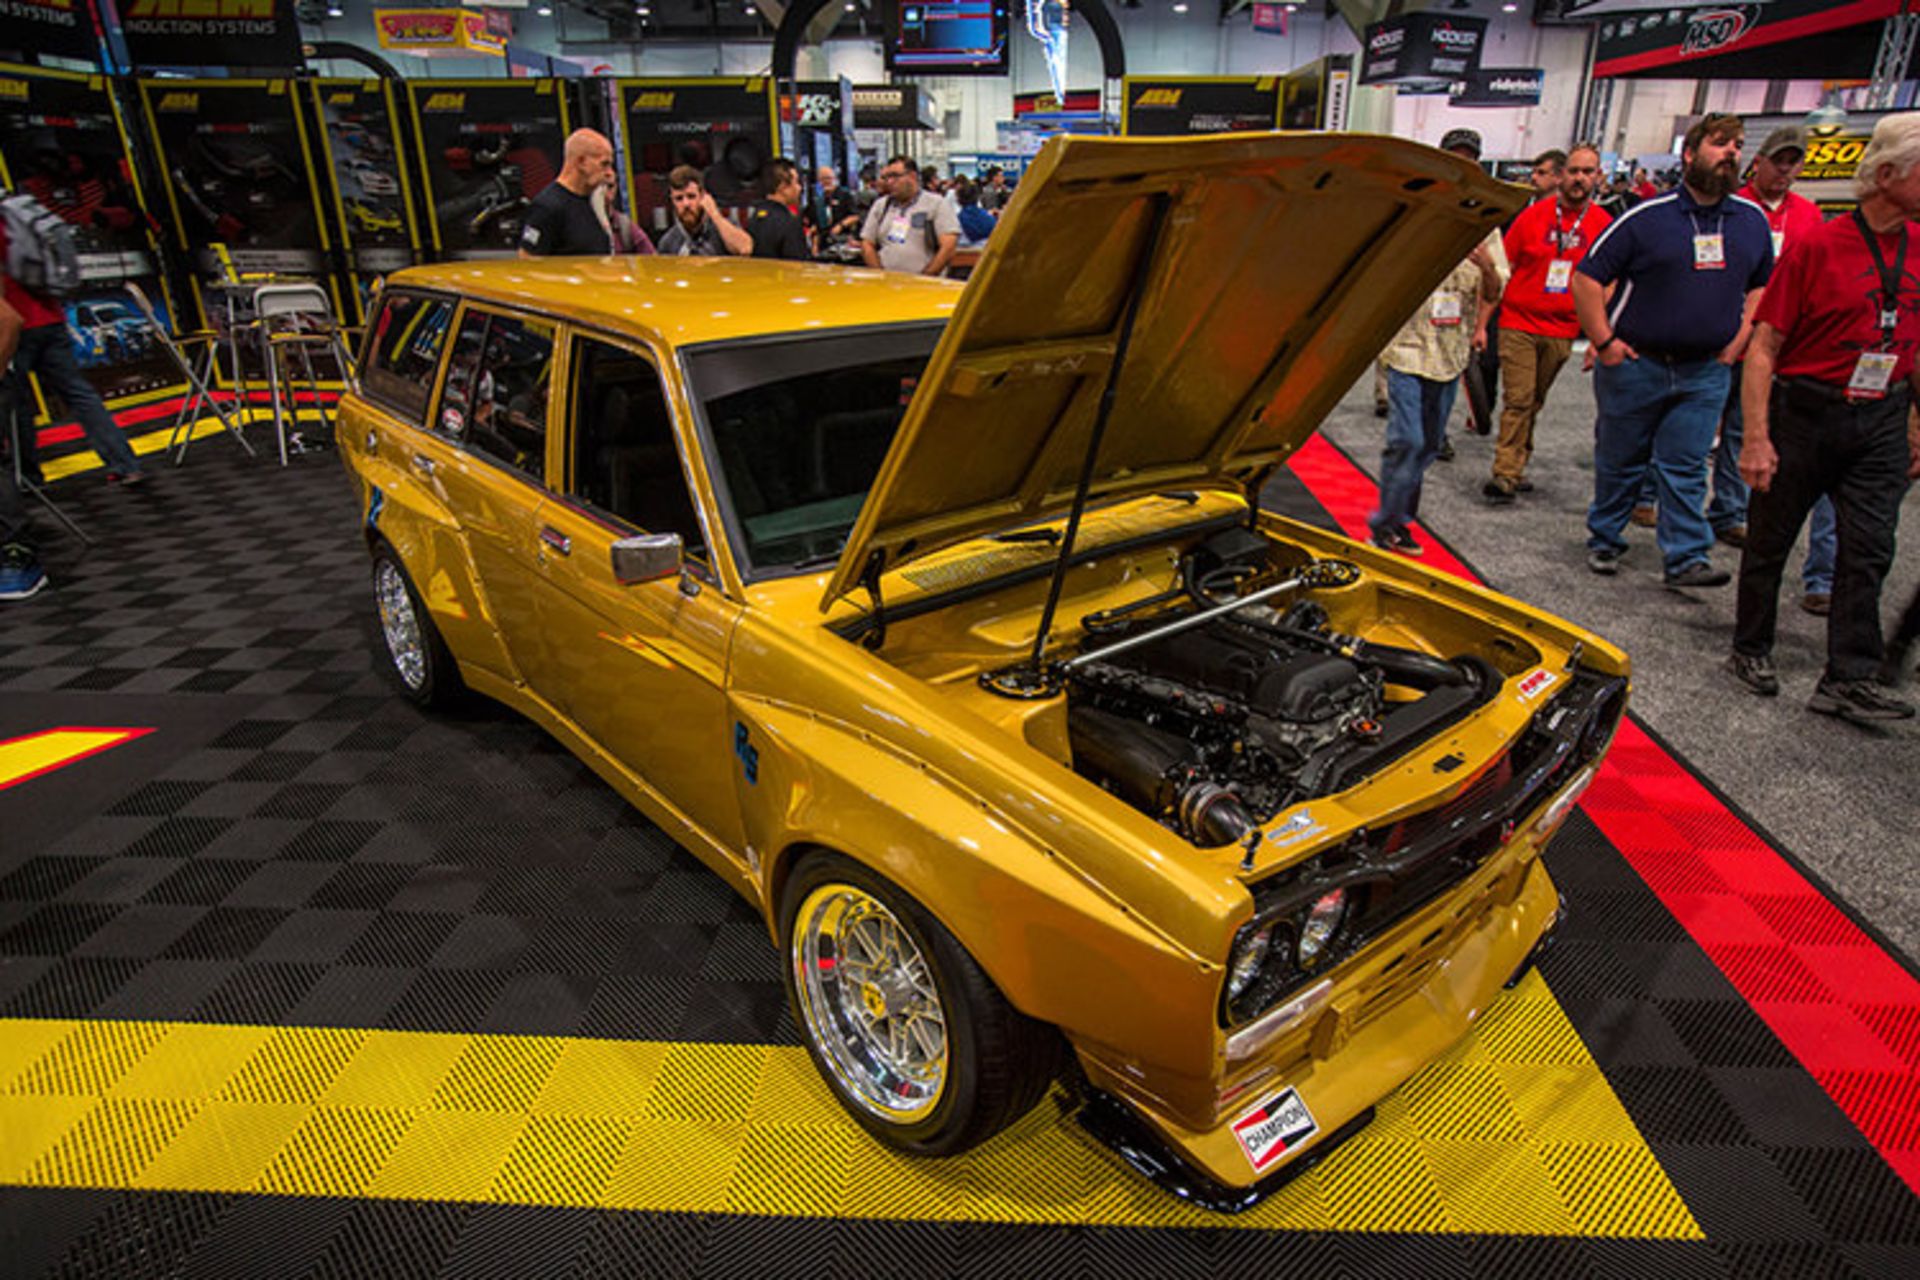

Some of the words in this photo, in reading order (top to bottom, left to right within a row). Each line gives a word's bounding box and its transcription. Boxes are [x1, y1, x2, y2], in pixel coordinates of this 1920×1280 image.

[10, 2, 76, 27] SYSTEMS
[207, 20, 276, 34] SYSTEMS
[1245, 1106, 1304, 1152] CHAMPION
